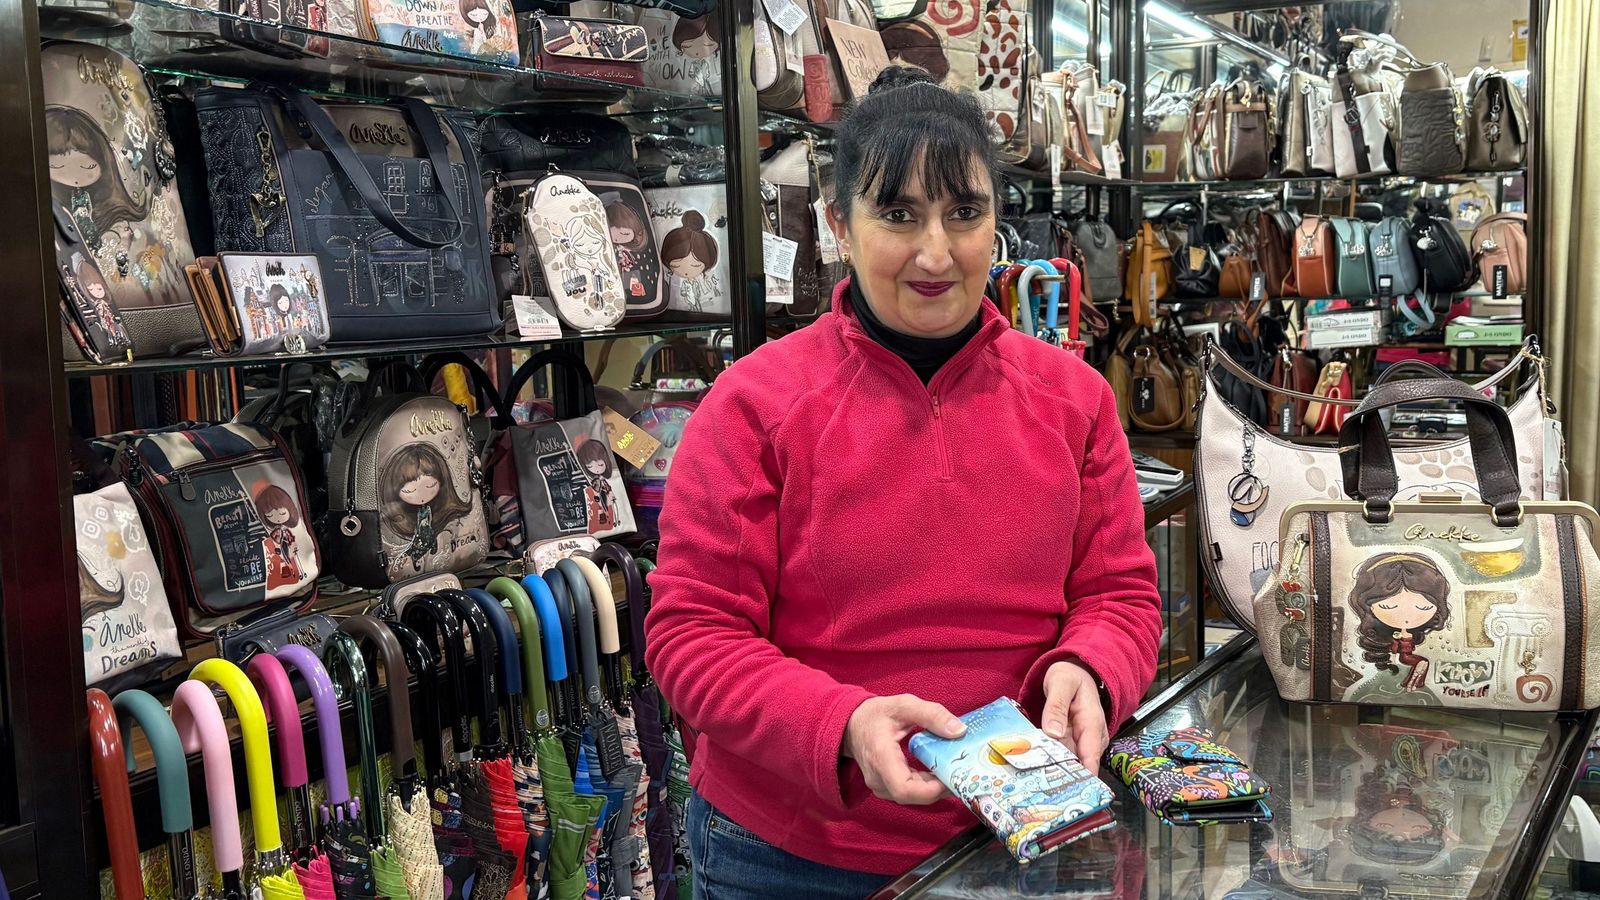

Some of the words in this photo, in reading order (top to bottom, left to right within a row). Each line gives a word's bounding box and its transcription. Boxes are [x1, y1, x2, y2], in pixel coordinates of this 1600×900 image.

[416, 14, 453, 26] BREATHE
[840, 37, 867, 60] NEW
[250, 560, 262, 576] BE
[101, 640, 158, 675] Dreams
[1434, 659, 1493, 687] KNOW
[1443, 683, 1491, 699] YOURSELF
[605, 725, 621, 769] VOGUE
